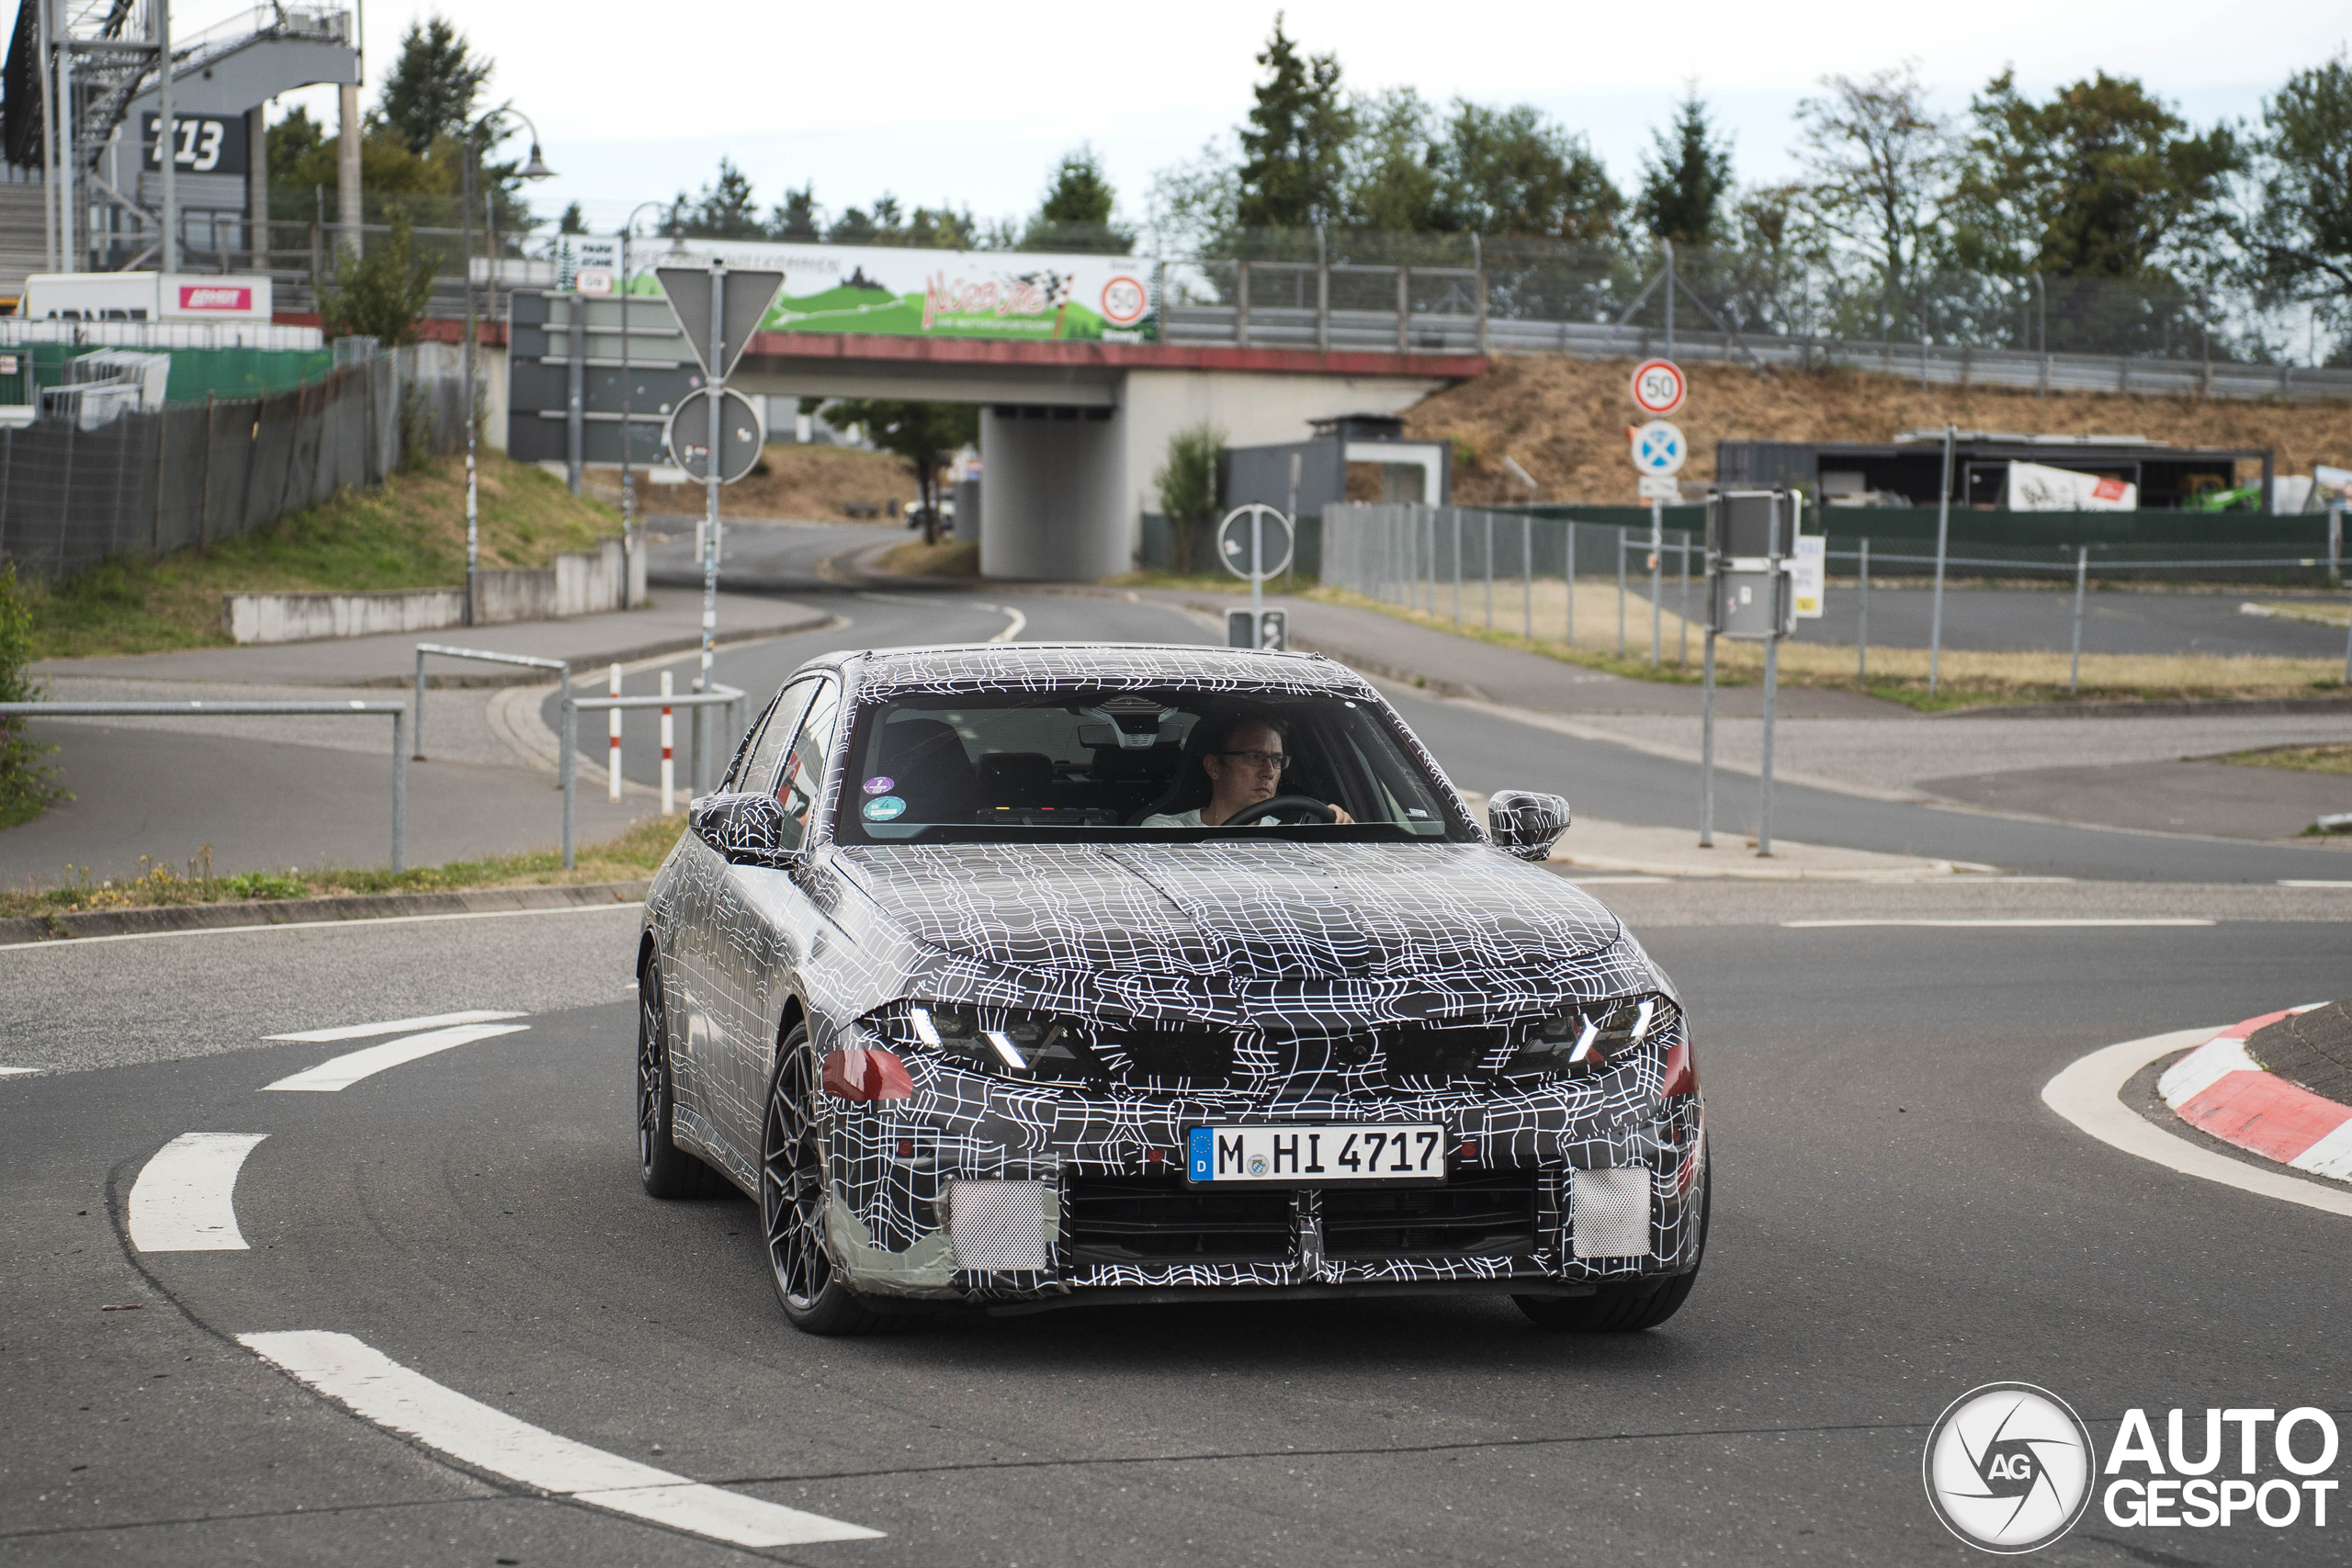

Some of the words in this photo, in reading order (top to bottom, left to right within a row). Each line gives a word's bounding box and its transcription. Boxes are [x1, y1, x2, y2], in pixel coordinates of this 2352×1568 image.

[150, 118, 224, 172] T13
[1110, 287, 1138, 310] 50
[1645, 376, 1674, 399] 50
[879, 799, 890, 809] 4
[1218, 1134, 1244, 1174] M
[1273, 1134, 1325, 1174] HI
[1338, 1131, 1439, 1173] 4717
[1197, 1161, 1206, 1172] D
